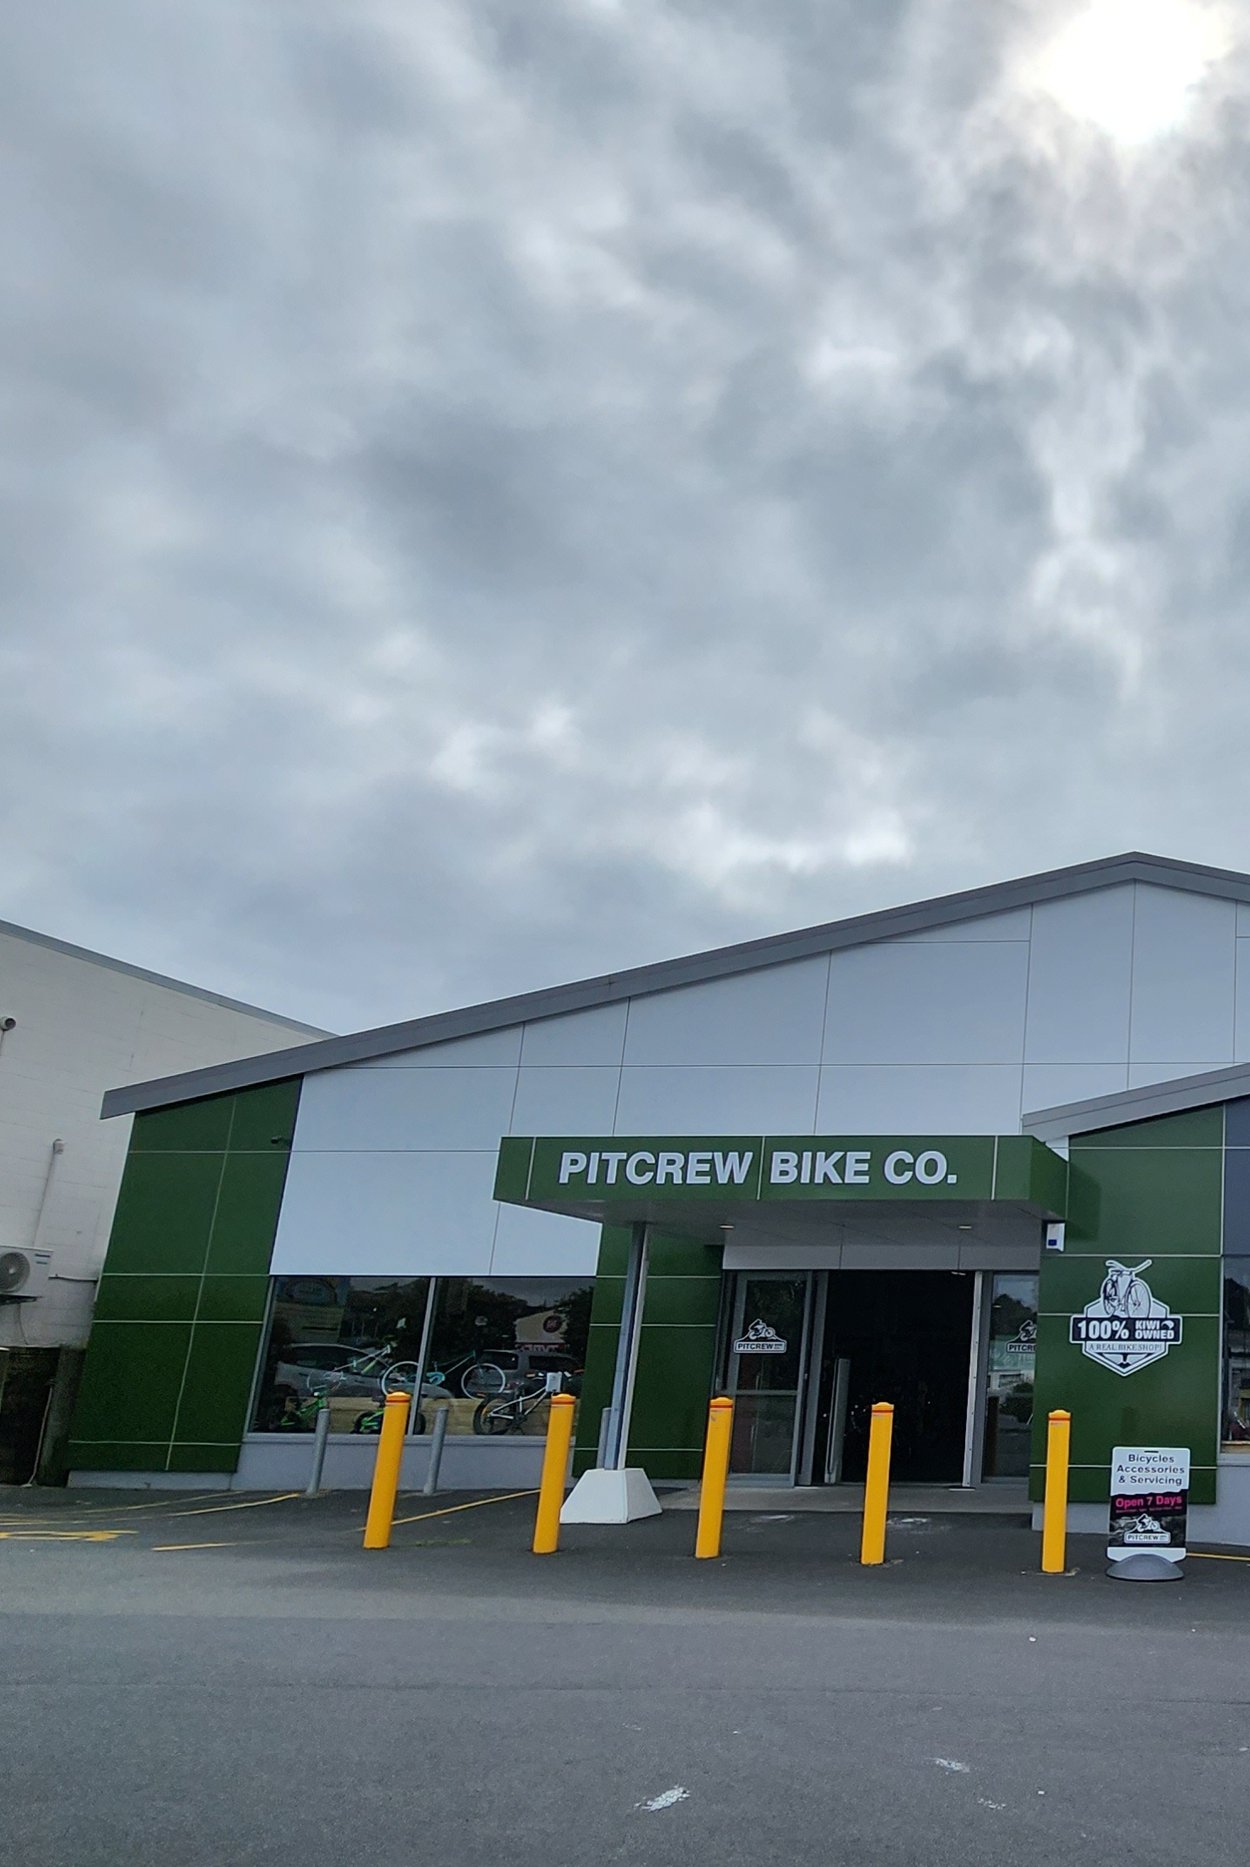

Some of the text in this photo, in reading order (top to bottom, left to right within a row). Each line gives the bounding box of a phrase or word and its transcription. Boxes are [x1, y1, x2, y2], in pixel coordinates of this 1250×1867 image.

[558, 1150, 957, 1184] PITCREW BIKE CO.
[1077, 1320, 1130, 1339] 100%
[1135, 1320, 1160, 1330] KIWI
[1134, 1330, 1174, 1339] OWNED
[1128, 1454, 1174, 1464] Bicycles
[1117, 1465, 1185, 1474] Accessories
[1130, 1476, 1182, 1486] Servicing
[1116, 1495, 1182, 1509] Open 7 Days
